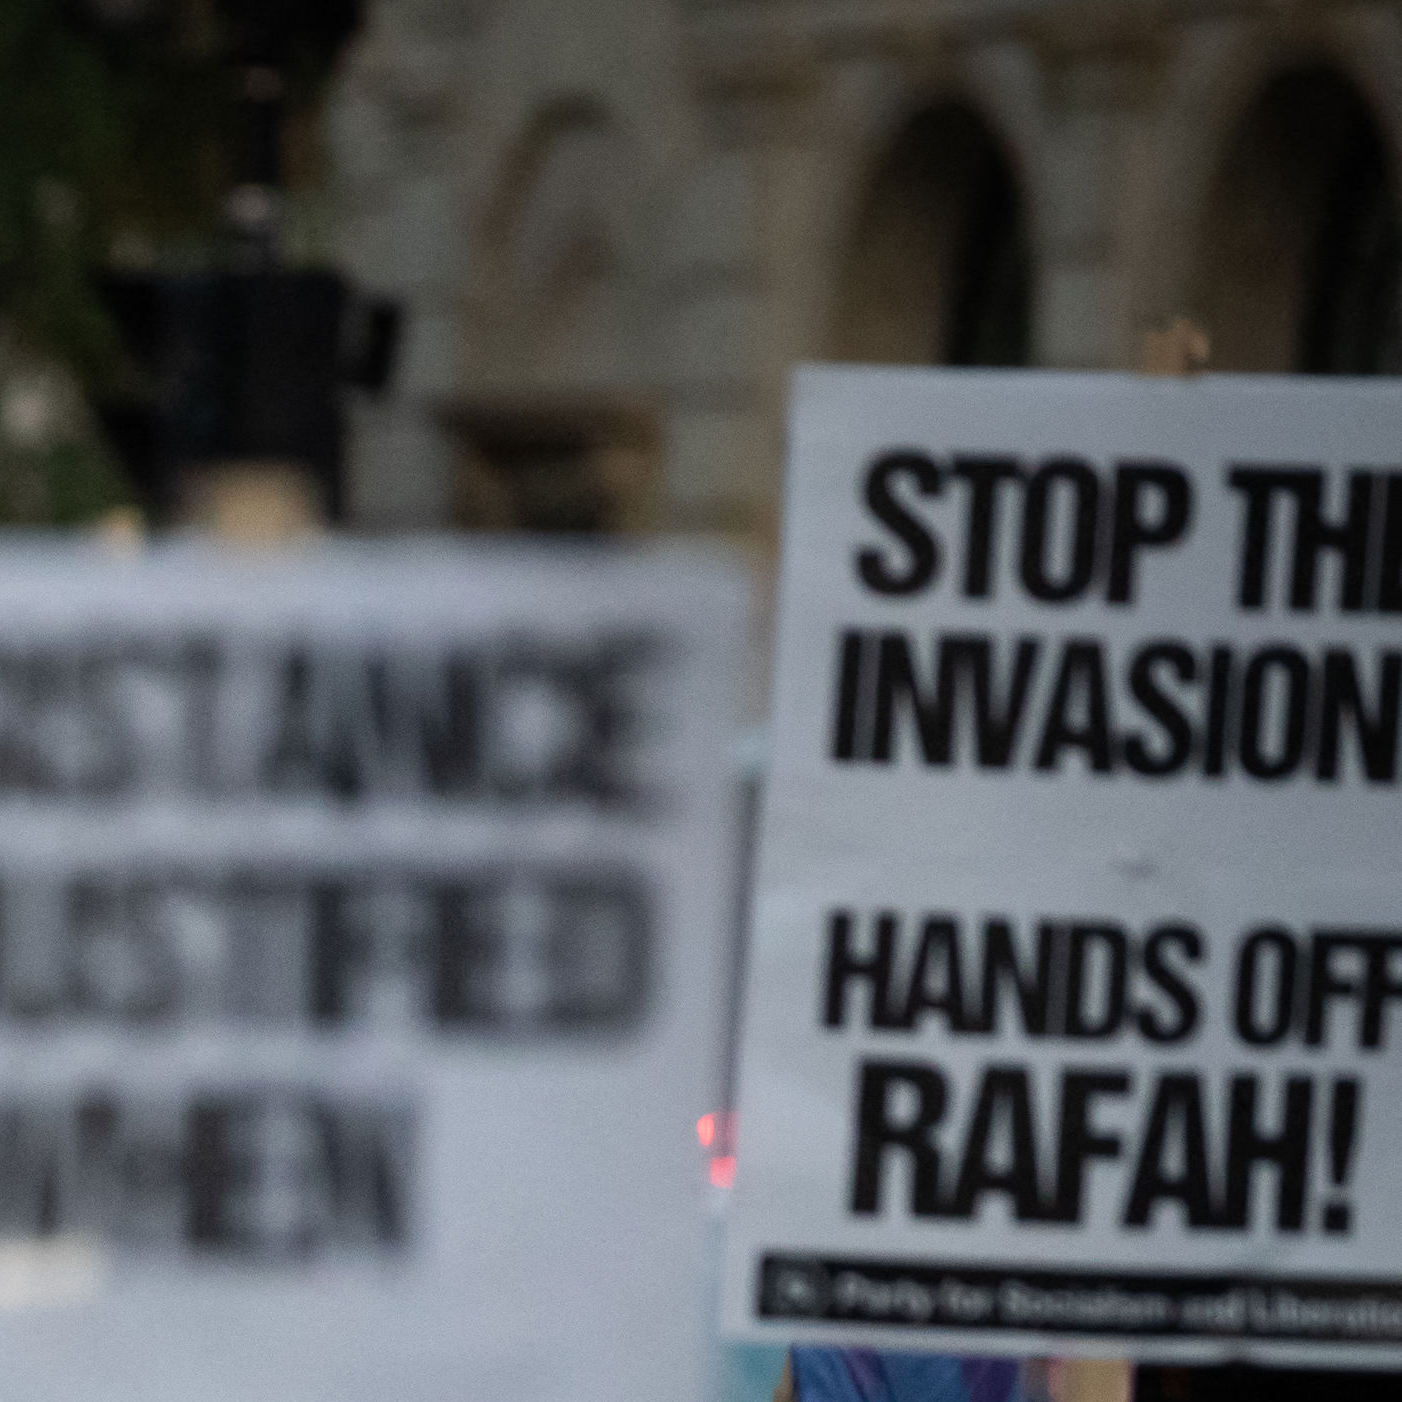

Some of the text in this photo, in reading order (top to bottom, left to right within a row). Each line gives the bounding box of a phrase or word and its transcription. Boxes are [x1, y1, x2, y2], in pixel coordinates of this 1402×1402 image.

[856, 448, 1193, 603] STOP
[833, 625, 1402, 782] INVASION
[821, 908, 1402, 1049] HANDS OFF
[850, 1054, 1362, 1236] RAFAH!
